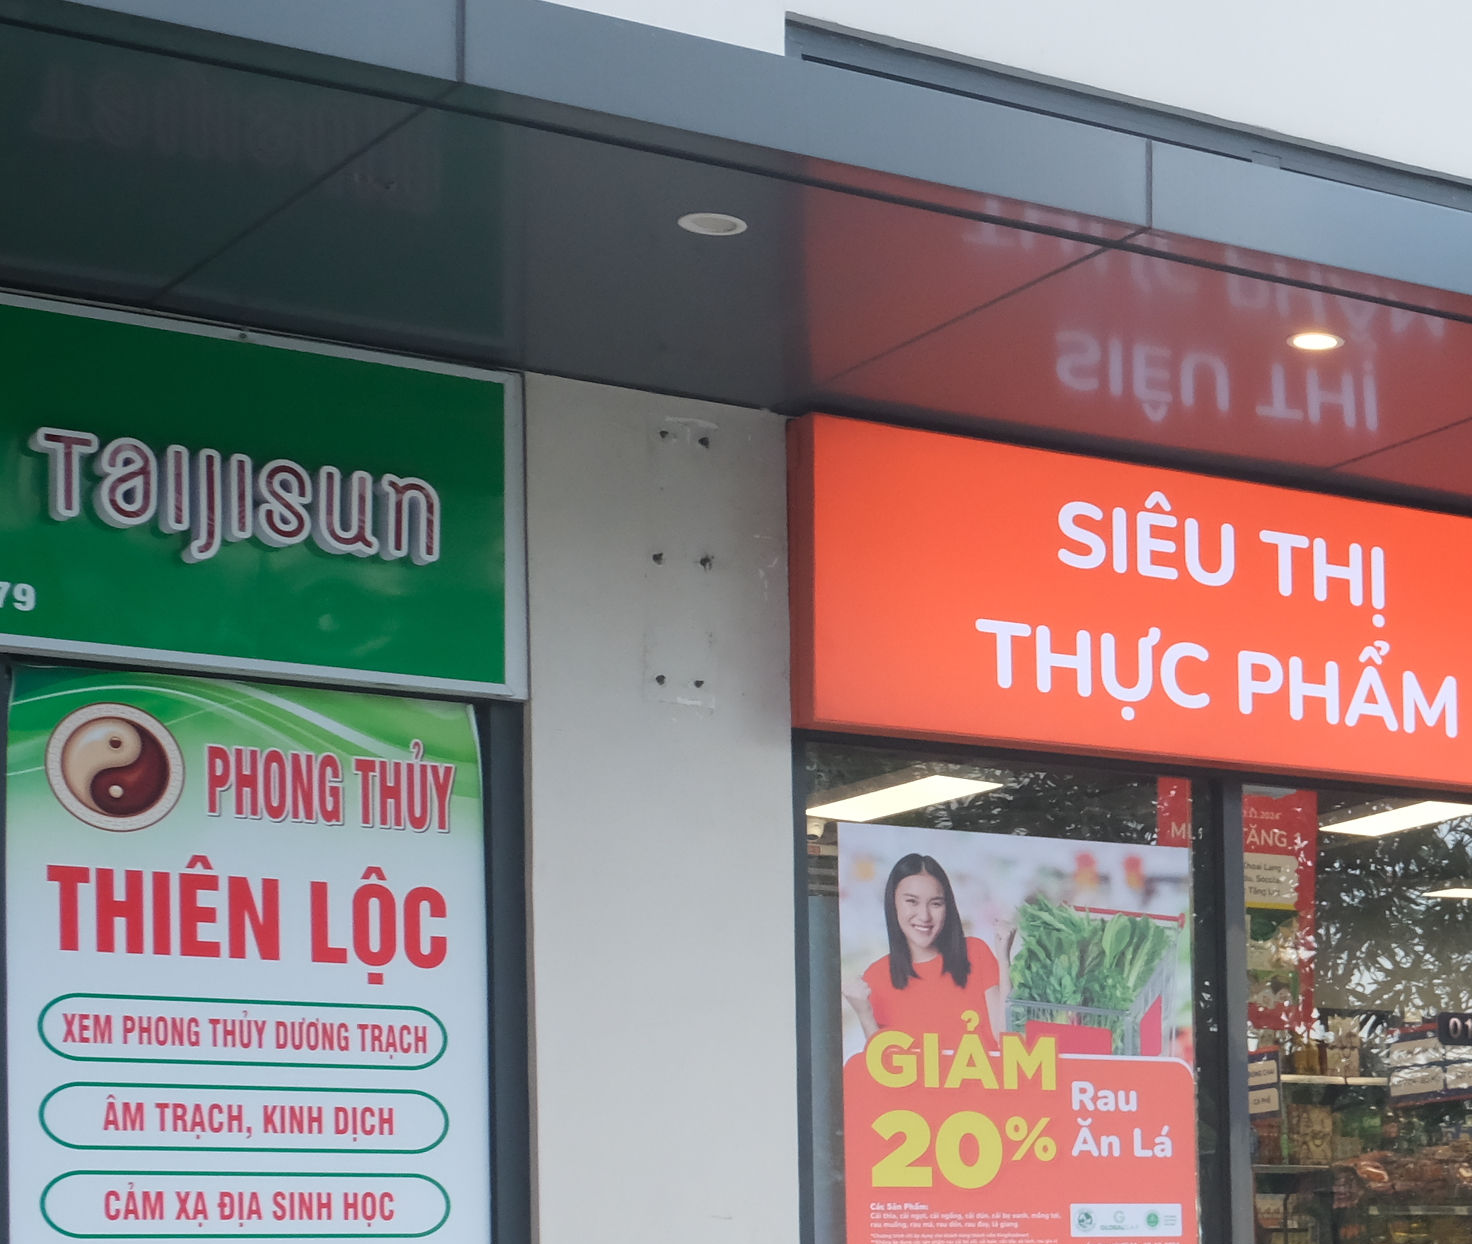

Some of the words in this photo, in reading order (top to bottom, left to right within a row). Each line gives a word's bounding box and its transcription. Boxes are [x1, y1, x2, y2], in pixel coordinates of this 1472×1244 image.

[1057, 491, 1235, 588] SIÊU
[1260, 529, 1386, 628] THỊ
[976, 619, 1211, 721] THỰC
[1238, 640, 1459, 739] PHẨM
[205, 743, 346, 827] PHONG
[354, 739, 455, 833] THỦY
[46, 854, 281, 961] THIÊN
[310, 866, 448, 985] LỘC
[62, 1011, 116, 1044] XEM
[122, 1014, 200, 1050] PHONG
[209, 1011, 269, 1053] THỦY
[275, 1016, 350, 1054] DƯƠNG
[356, 1022, 428, 1061] TRẠCH
[864, 1010, 1057, 1091] GIẢM
[103, 1098, 150, 1133] ÂM
[155, 1102, 254, 1146] TRẠCH,
[263, 1102, 324, 1136] KINH
[330, 1105, 395, 1144] DỊCH
[1071, 1080, 1137, 1112] Rau
[871, 1109, 1057, 1189] 20%
[1071, 1118, 1121, 1157] Ăn
[1133, 1124, 1172, 1158] Lá
[103, 1183, 166, 1223] CẢM
[173, 1192, 211, 1229] XẠ
[217, 1190, 266, 1229] ĐỊA
[272, 1190, 335, 1223] SINH
[342, 1190, 395, 1229] HỌC
